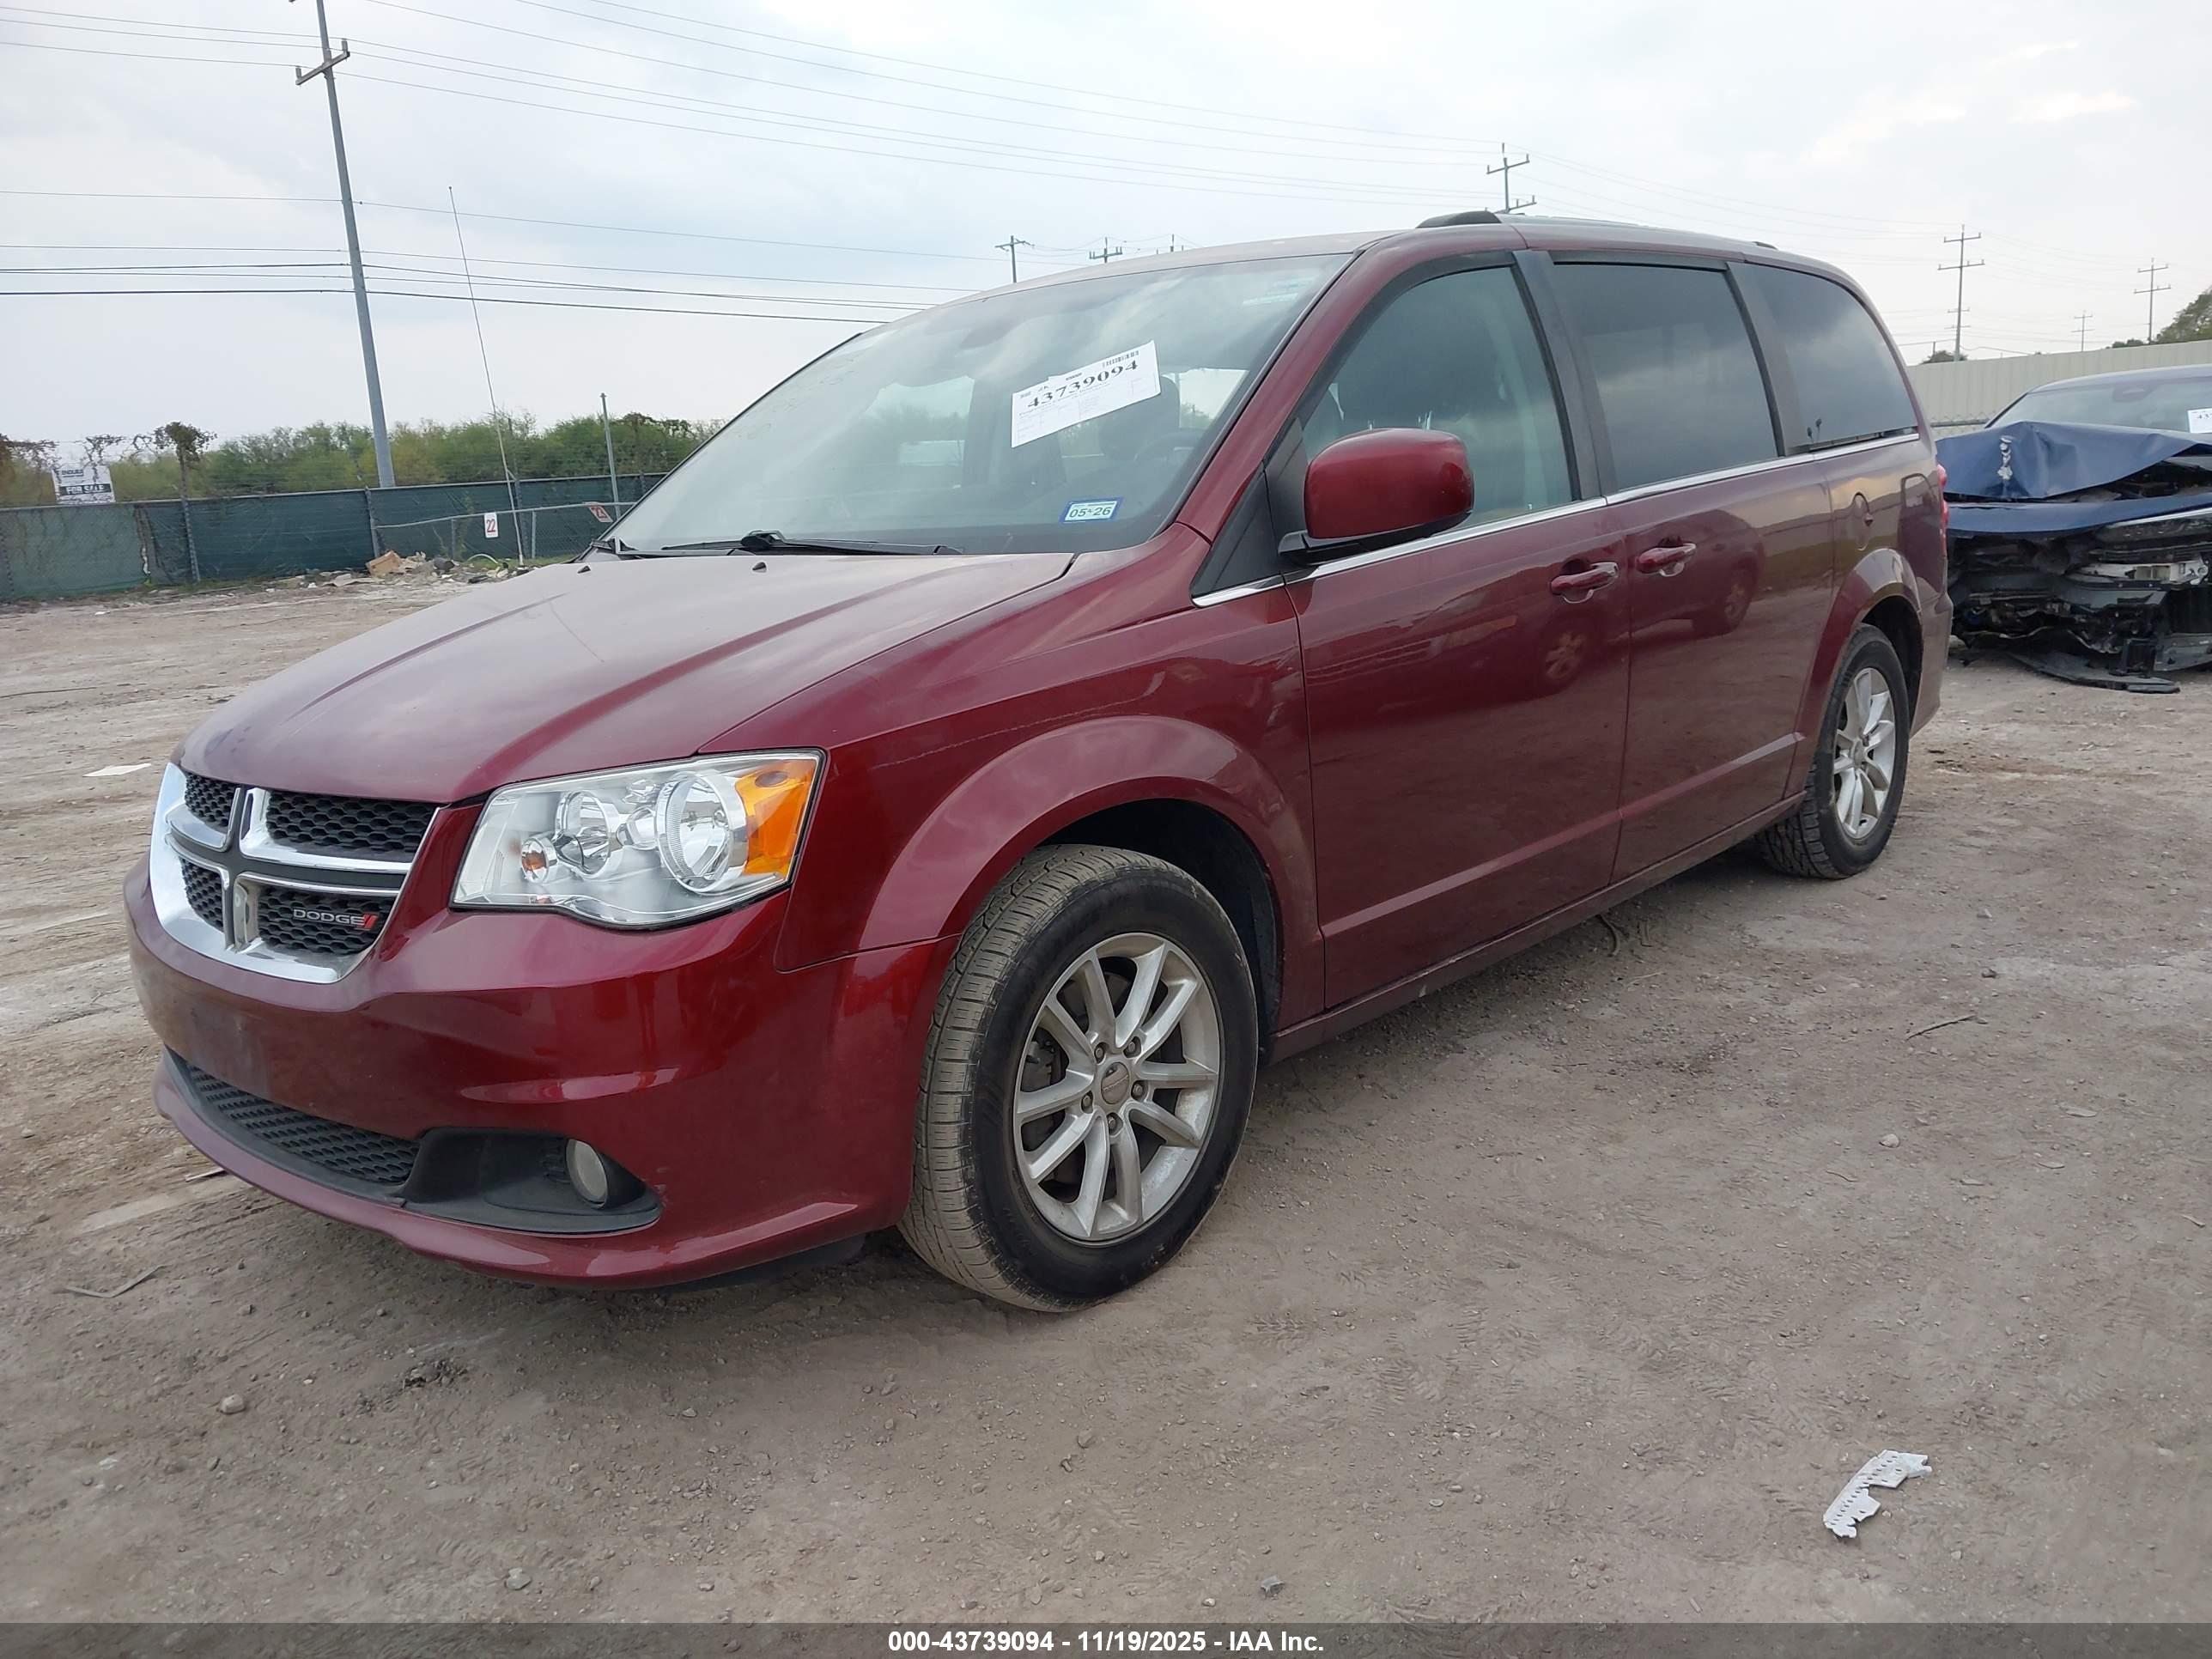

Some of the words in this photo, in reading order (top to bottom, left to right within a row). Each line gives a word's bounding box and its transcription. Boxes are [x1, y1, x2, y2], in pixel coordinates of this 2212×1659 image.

[1027, 361, 1139, 407] 43739094
[1069, 508, 1086, 518] 05
[1092, 507, 1112, 516] 26
[487, 519, 496, 532] 22
[293, 908, 365, 926] DODGE
